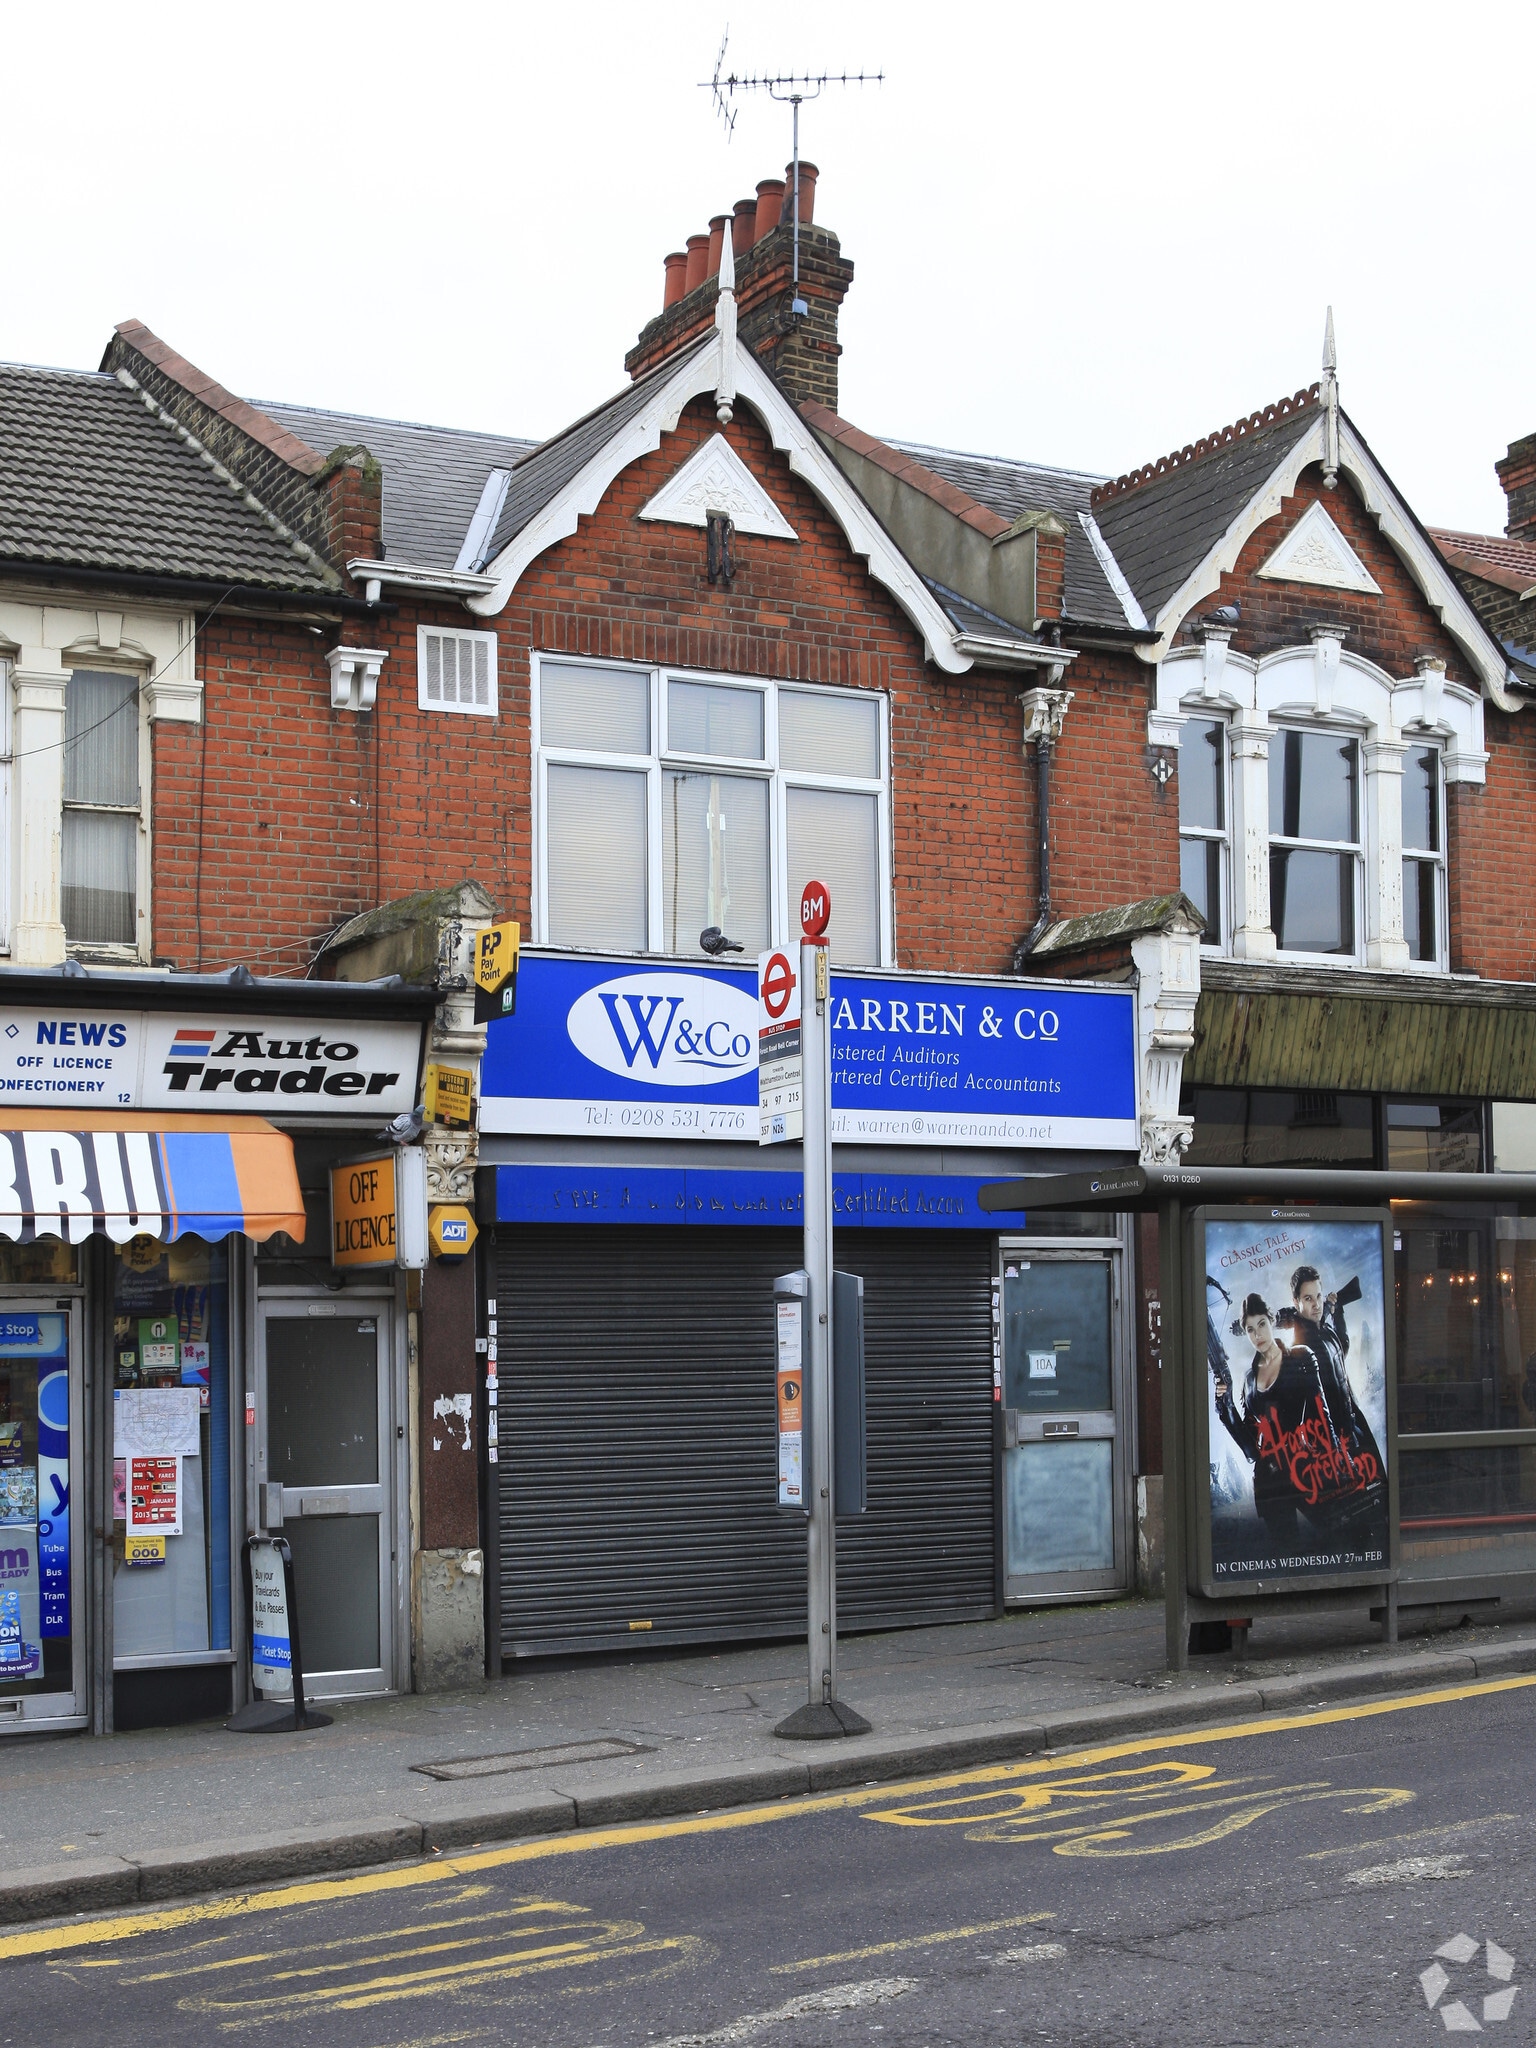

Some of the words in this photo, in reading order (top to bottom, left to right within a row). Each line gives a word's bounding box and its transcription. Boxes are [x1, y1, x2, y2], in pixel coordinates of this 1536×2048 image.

[803, 896, 823, 922] BM
[481, 958, 494, 970] Pay
[481, 968, 500, 982] Point
[830, 997, 966, 1036] ARREN
[978, 1006, 1002, 1038] &
[36, 1022, 126, 1047] NEWS
[598, 993, 750, 1068] W&Co
[776, 1024, 786, 1032] STOP
[210, 1032, 358, 1062] Auto
[769, 1044, 777, 1052] Road
[786, 1040, 799, 1048] Corner
[16, 1056, 44, 1068] OFF
[54, 1057, 112, 1069] LICENCE
[892, 1046, 960, 1066] Auditors
[163, 1062, 400, 1096] Trader
[785, 1070, 800, 1080] Central
[830, 1069, 882, 1086] rtered
[889, 1069, 958, 1091] Certified
[964, 1073, 1061, 1093] Accountants
[118, 1093, 130, 1102] 12
[775, 1095, 781, 1105] 97
[789, 1092, 799, 1102] 215
[584, 1107, 613, 1125] Tel:
[621, 1108, 664, 1127] 0208
[671, 1109, 700, 1127] 531
[709, 1111, 745, 1128] 7776
[773, 1124, 784, 1134] N26
[858, 1117, 1052, 1139] warren@warrenandco.net
[1163, 1174, 1179, 1182] 0131
[1181, 1176, 1200, 1184] 0260
[350, 1170, 378, 1204] OFF
[336, 1214, 396, 1252] LICENCE
[442, 1224, 466, 1238] ADT
[1220, 1243, 1262, 1268] CLASSIC
[1264, 1232, 1290, 1249] TALE
[1249, 1254, 1272, 1272] NEW
[1274, 1240, 1306, 1260] TWIST
[6, 1324, 34, 1336] Stop
[1036, 1359, 1053, 1370] 10A
[1216, 1563, 1227, 1573] IN
[1230, 1559, 1276, 1572] CINEMAS
[1279, 1554, 1342, 1568] WEDNESDAY
[1365, 1551, 1383, 1561] FEB
[0, 1569, 29, 1578] EADY
[46, 1568, 62, 1576] Bus
[264, 1572, 273, 1582] your
[255, 1585, 280, 1597] Travelcards
[267, 1603, 284, 1614] Passes
[46, 1616, 63, 1624] DLR
[0, 1626, 20, 1637] ON
[262, 1645, 276, 1658] Ticket
[278, 1648, 291, 1661] Stop
[860, 1762, 1417, 1857] BUS
